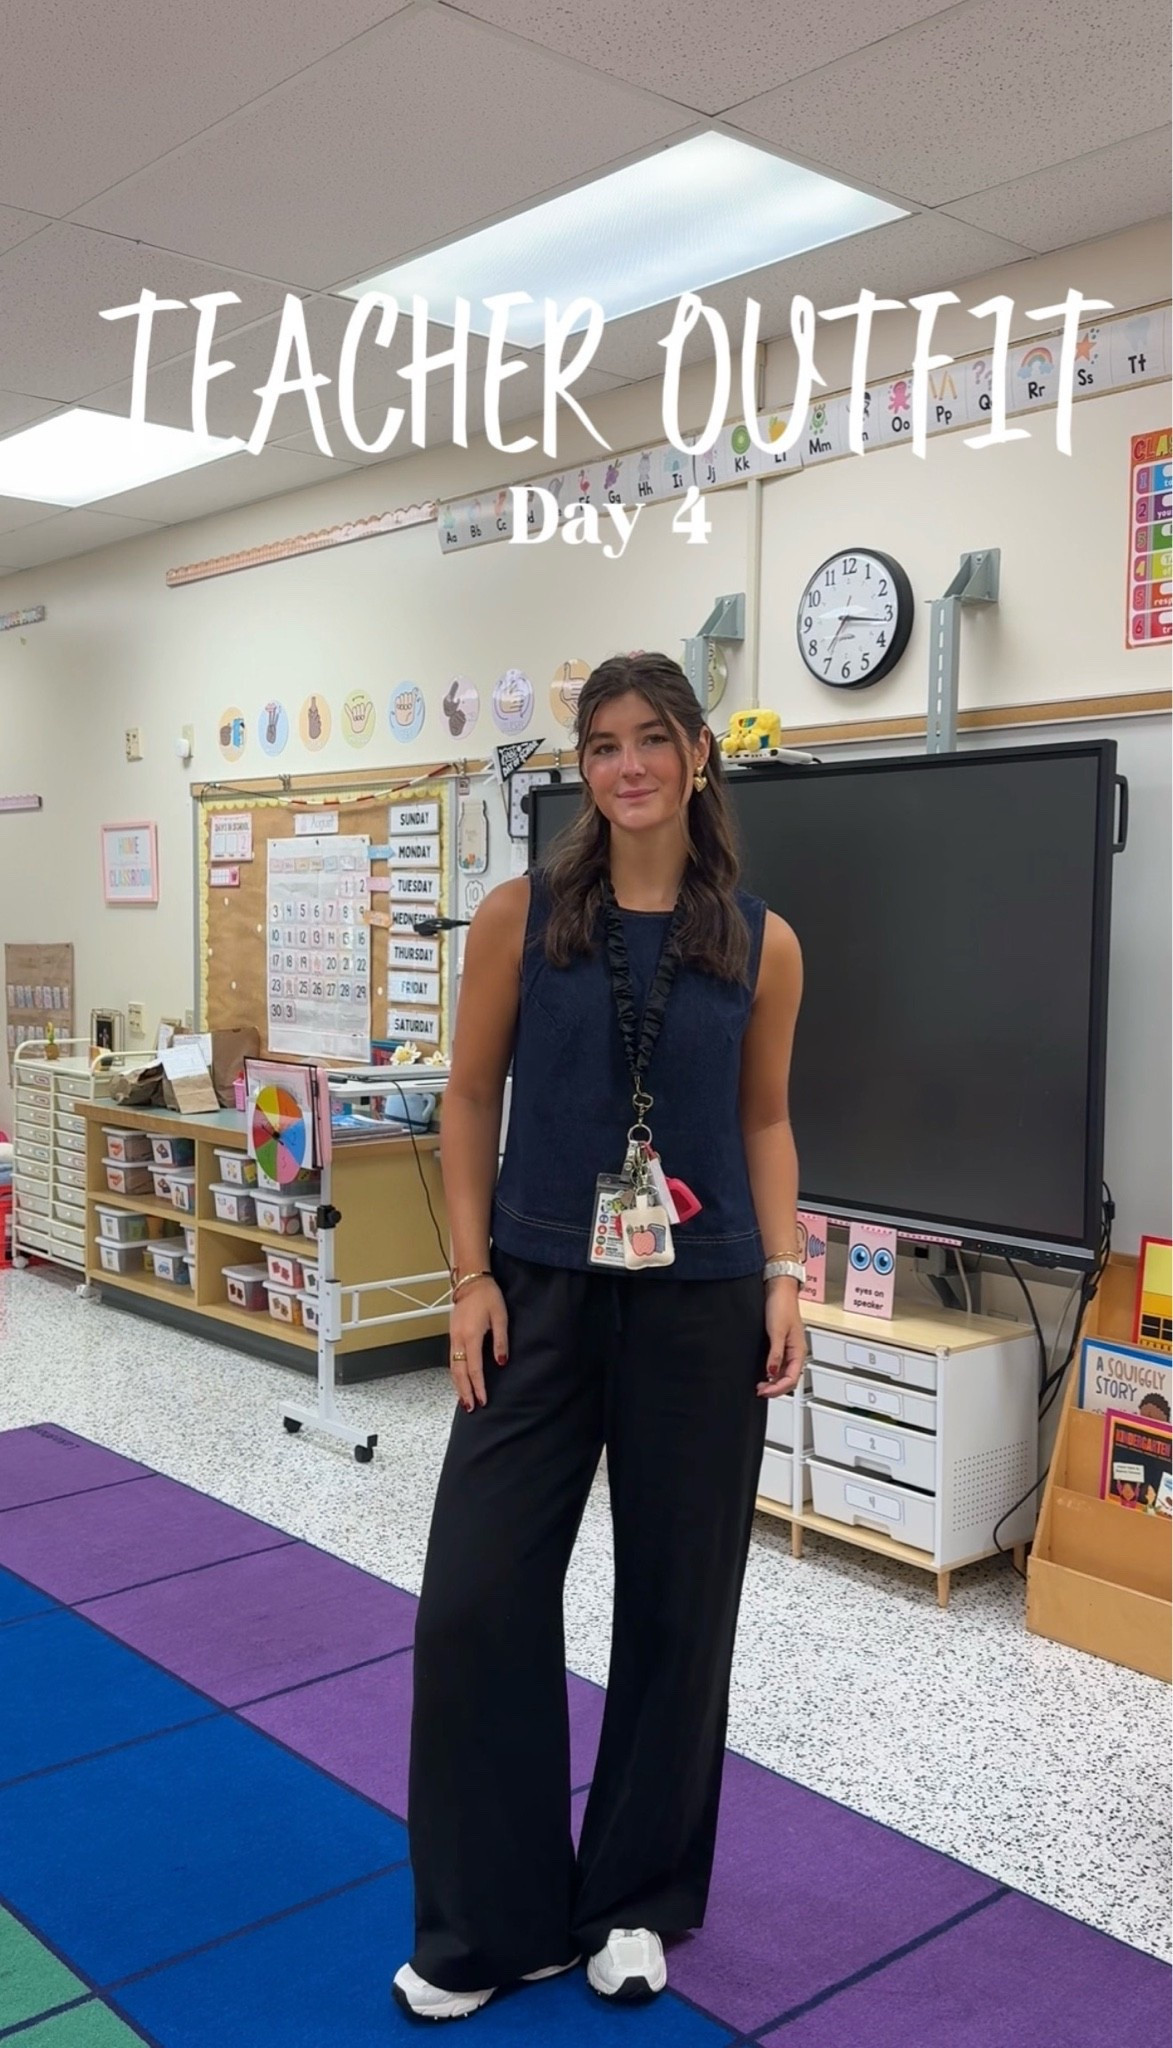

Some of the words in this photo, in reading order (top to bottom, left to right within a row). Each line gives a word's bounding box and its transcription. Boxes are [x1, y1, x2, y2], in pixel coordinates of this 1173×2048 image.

[446, 531, 458, 543] Aa
[470, 525, 482, 538] Bb
[496, 518, 507, 531] Cc
[638, 482, 653, 497] Hh
[673, 474, 683, 488] Ii
[707, 466, 716, 483] Jj
[734, 457, 750, 472] Kk
[809, 438, 832, 455] Mm
[892, 416, 910, 432] Oo
[936, 405, 952, 425] Pp
[979, 394, 992, 411] Q
[1028, 381, 1045, 399] Rr
[1077, 369, 1094, 386] Ss
[1128, 354, 1147, 374] Tt
[1133, 434, 1172, 461] CLA
[1138, 503, 1147, 518] 2
[842, 558, 858, 575] 12
[865, 563, 872, 579] 1
[1136, 560, 1146, 577] 4
[825, 570, 835, 587] 11
[878, 579, 888, 597] 2
[808, 590, 821, 608] 10
[883, 605, 894, 622] 3
[804, 617, 813, 633] 9
[1135, 620, 1143, 634] 6
[876, 631, 886, 647] 4
[808, 640, 818, 656] 8
[823, 658, 832, 675] 7
[842, 661, 851, 678] 6
[860, 653, 870, 670] 5
[400, 811, 429, 826] SUNDAY
[398, 846, 431, 858] MONDAY
[360, 879, 365, 893] 2
[398, 879, 433, 893] TUESDAY
[273, 905, 279, 918] 3
[286, 904, 292, 917] 4
[300, 904, 306, 917] 5
[314, 905, 320, 918] 6
[328, 905, 334, 917] 7
[343, 905, 349, 918] 8
[272, 929, 280, 942] 10
[300, 930, 306, 944] 12
[313, 930, 320, 944] 13
[328, 932, 335, 944] 14
[358, 932, 365, 945] 16
[394, 946, 433, 961] THURSDAY
[273, 954, 280, 967] 17
[286, 955, 293, 968] 18
[300, 956, 307, 968] 19
[326, 957, 336, 970] 20
[357, 958, 366, 971] 22
[272, 979, 280, 992] 23
[299, 981, 308, 994] 25
[313, 982, 322, 995] 26
[327, 983, 336, 996] 27
[340, 984, 349, 997] 28
[356, 985, 366, 998] 29
[401, 981, 428, 994] FRIDAY
[271, 1004, 282, 1017] 30
[394, 1018, 433, 1034] SATURDAY
[855, 1287, 872, 1296] eyes
[873, 1290, 884, 1298] on
[853, 1299, 884, 1310] speaker
[1096, 1356, 1104, 1372] A
[1107, 1357, 1166, 1391] SQUIGGLY
[1095, 1375, 1138, 1402] STORY
[868, 1392, 877, 1404] D
[869, 1438, 876, 1450] 2
[869, 1496, 876, 1508] 4
